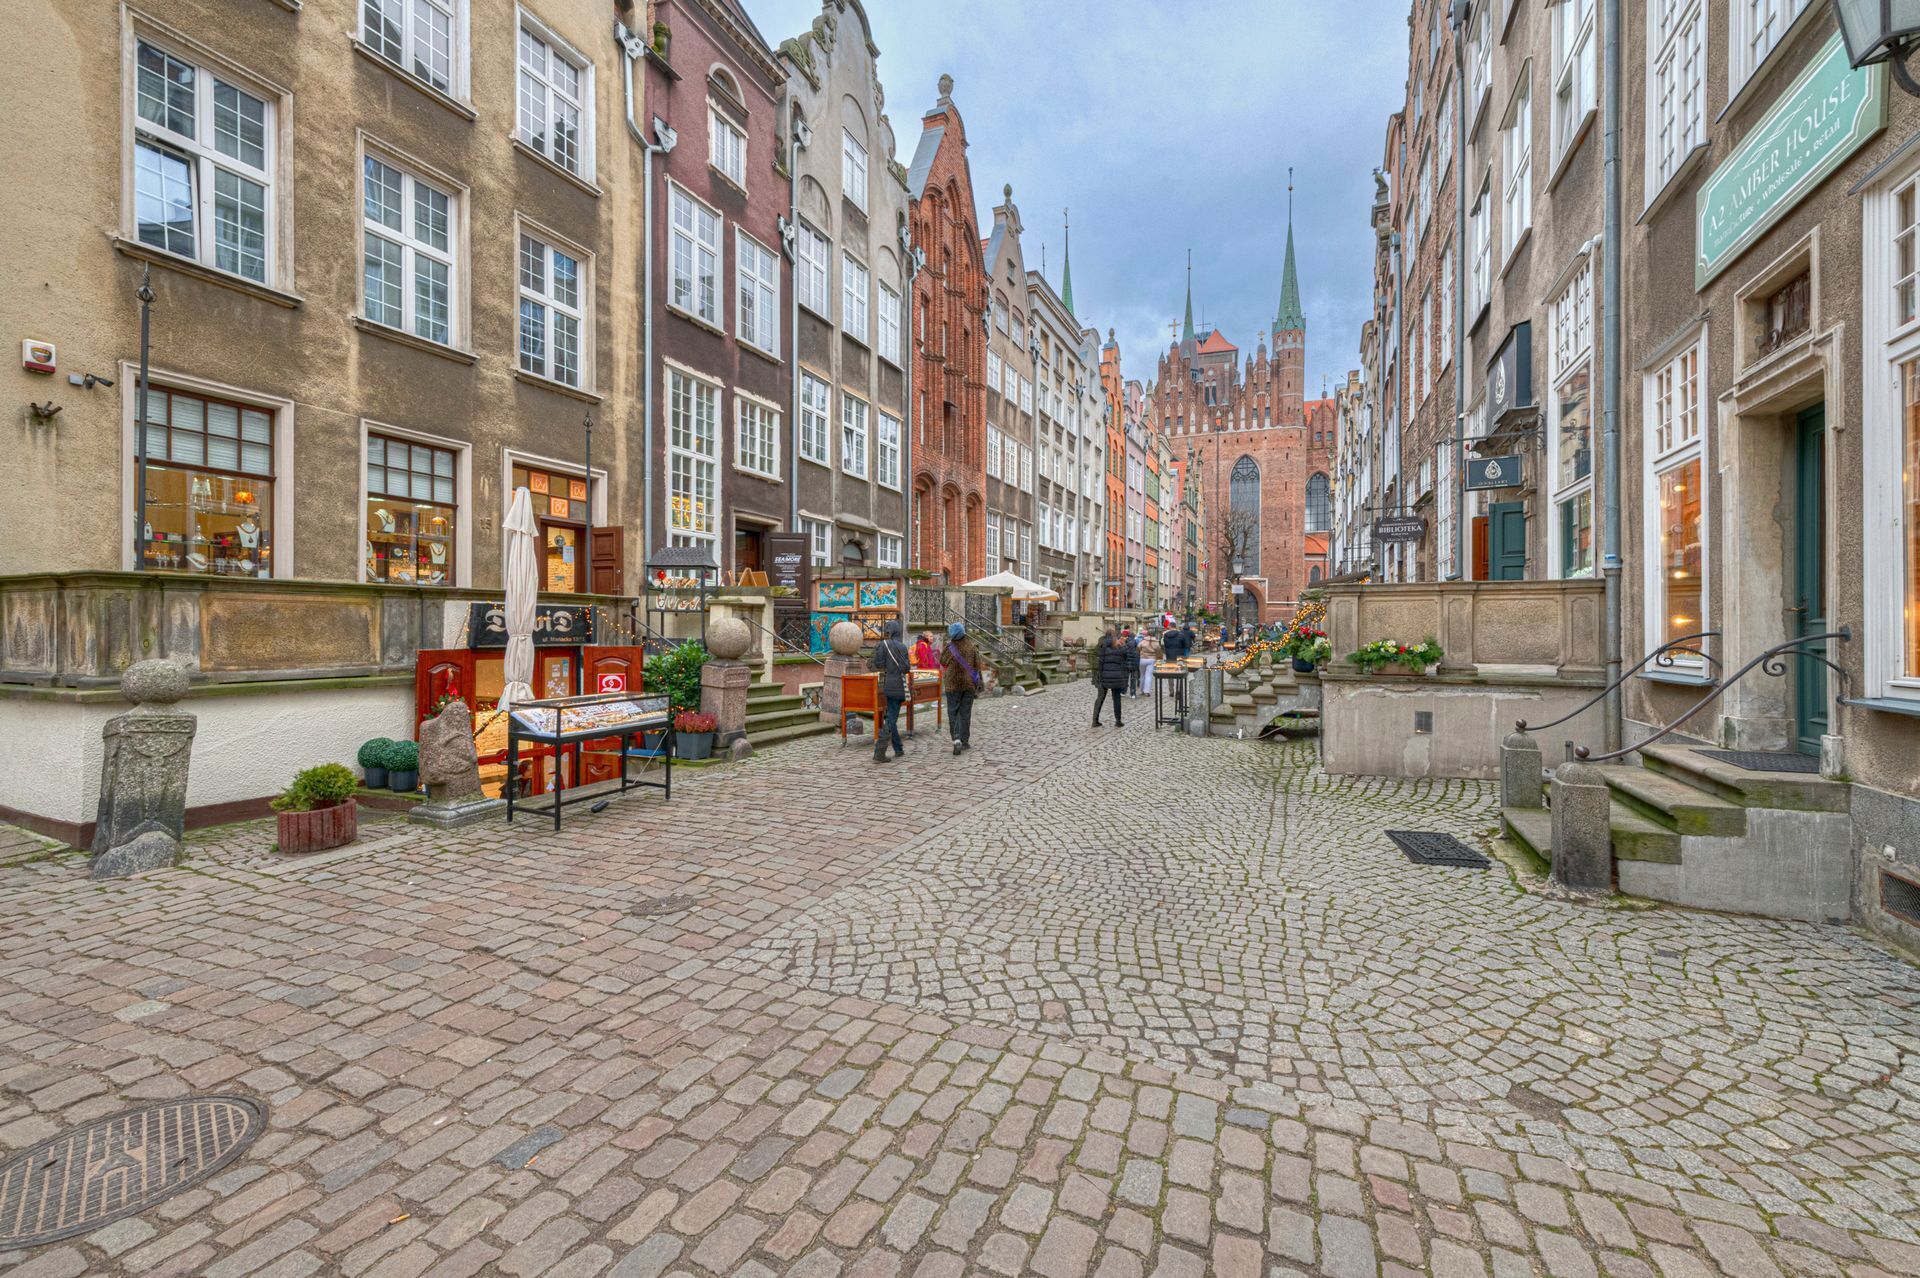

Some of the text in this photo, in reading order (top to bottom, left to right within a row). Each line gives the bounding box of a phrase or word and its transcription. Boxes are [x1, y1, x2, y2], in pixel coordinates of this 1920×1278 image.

[1708, 73, 1851, 237] A2 AMBER HOUSE
[1762, 155, 1803, 201] wholesale
[1378, 525, 1422, 534] BIBLIOTEKA
